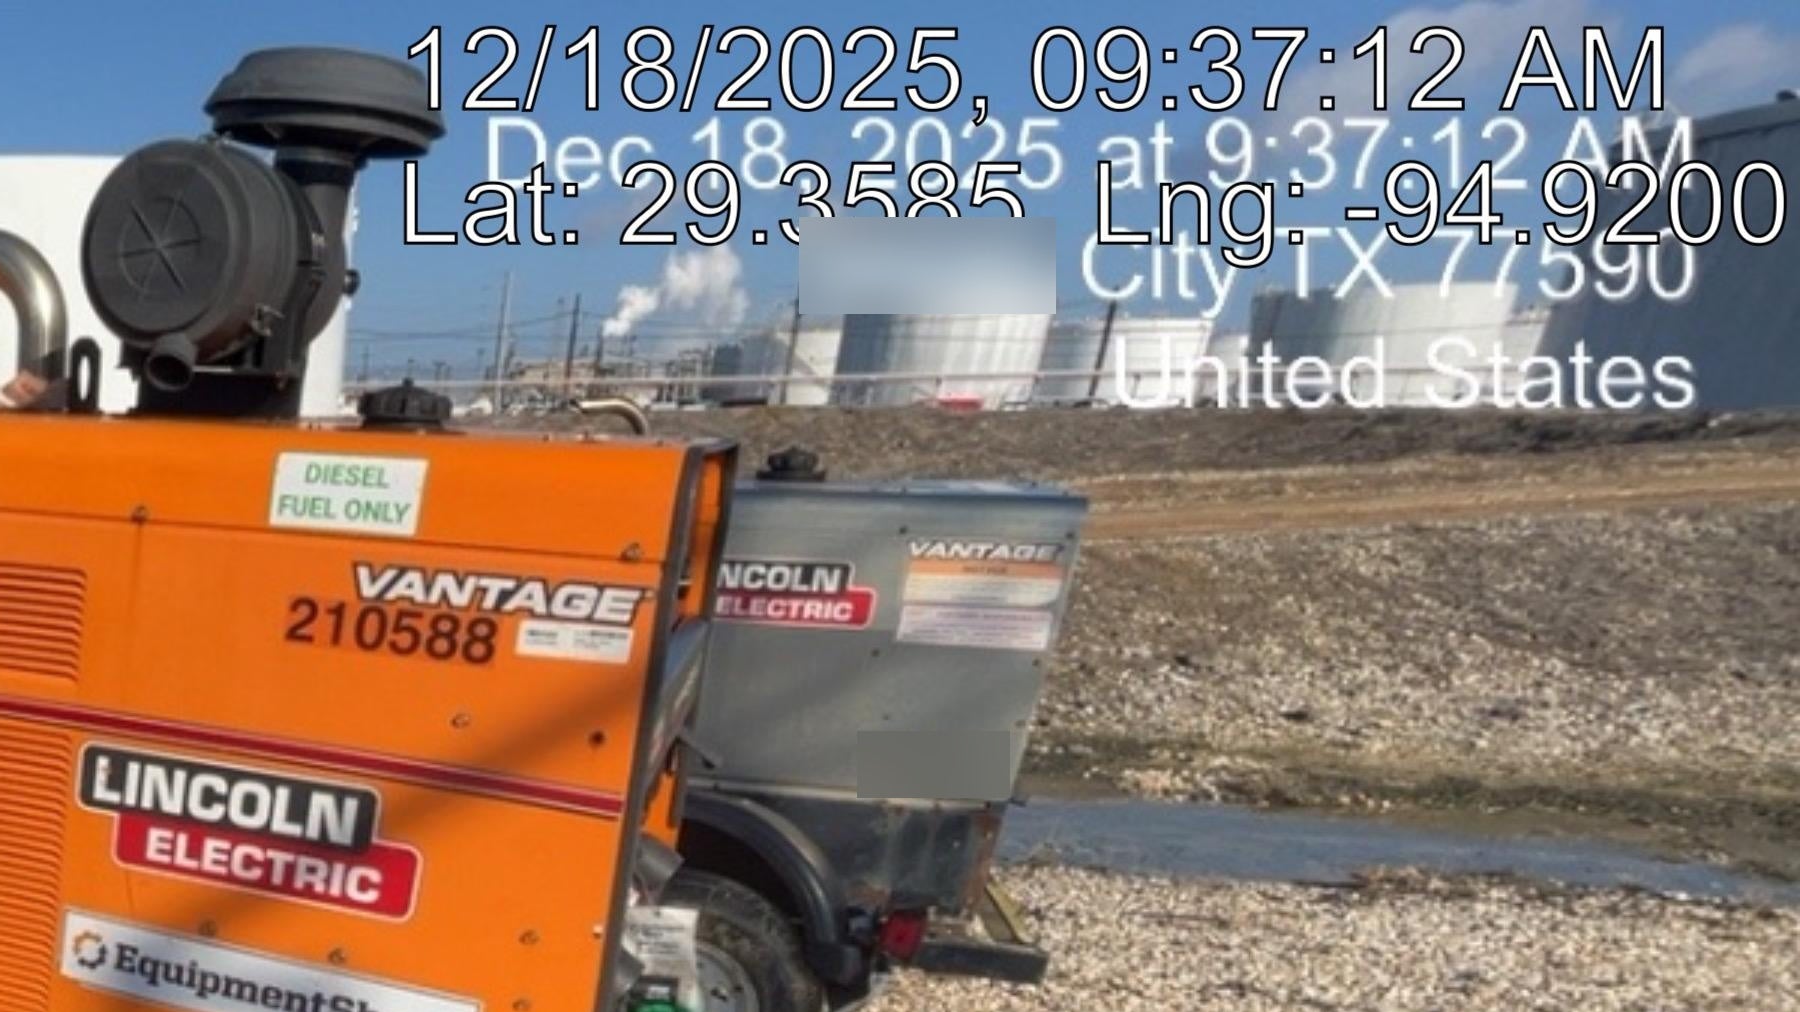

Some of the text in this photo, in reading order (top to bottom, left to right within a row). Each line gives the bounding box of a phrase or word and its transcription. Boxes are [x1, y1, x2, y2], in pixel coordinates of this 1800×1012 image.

[305, 462, 391, 490] DIESEL
[277, 494, 412, 525] FUEL ONLY
[354, 562, 646, 624] VANTAGE
[716, 563, 842, 593] NCOLN
[285, 596, 499, 664] 210588
[715, 596, 855, 622] ELECTRIC
[92, 755, 359, 847] LINCOLN
[145, 827, 384, 905] ELECTRIC
